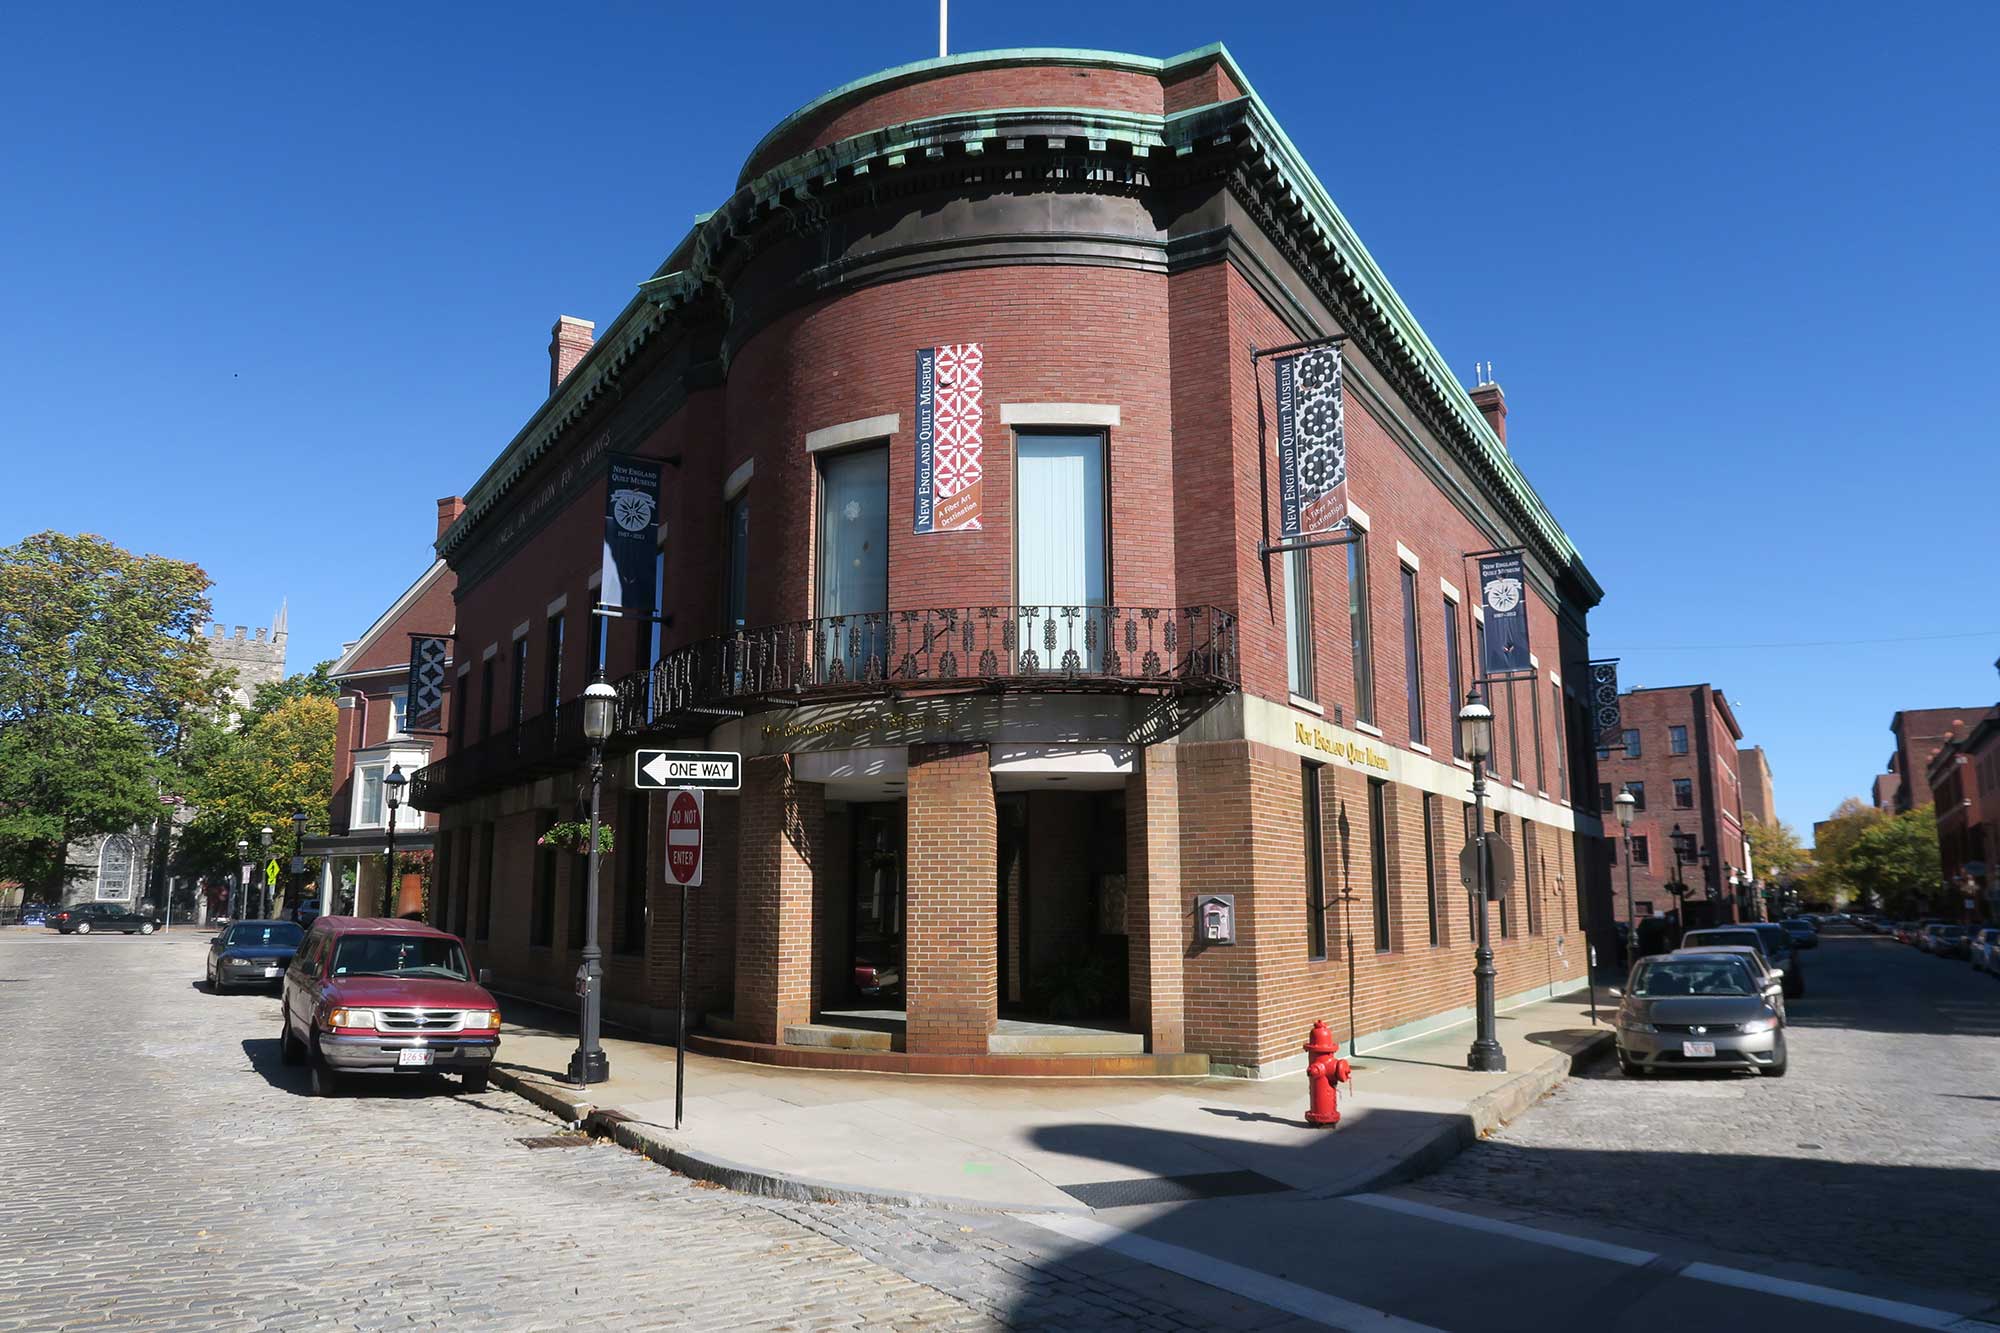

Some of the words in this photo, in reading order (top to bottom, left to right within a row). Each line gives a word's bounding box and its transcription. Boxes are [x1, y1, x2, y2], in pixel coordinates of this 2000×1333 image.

[920, 357, 932, 406] MUSEUM
[1281, 363, 1293, 413] MUSEUM
[919, 409, 931, 441] QUILT
[1282, 415, 1294, 447] QUILT
[612, 474, 629, 482] QUILT
[630, 476, 657, 487] MUSEUM
[613, 465, 627, 474] NEW
[629, 468, 657, 479] ENGLAND
[919, 442, 931, 495] ENGLAND
[1283, 449, 1296, 501] ENGLAND
[918, 495, 930, 525] NEW
[938, 510, 944, 518] A
[944, 501, 960, 514] Fiber
[960, 494, 971, 504] Art
[941, 502, 977, 526] Destination
[1286, 504, 1297, 532] NEW
[1309, 503, 1344, 530] Destination
[1295, 722, 1312, 746] NEW
[1314, 728, 1345, 757] ENGLAND
[1346, 742, 1365, 765] QUILT
[1366, 747, 1389, 771] MUSEUM
[669, 763, 698, 776] ONE
[702, 764, 729, 777] WAY
[672, 811, 680, 824] DO
[684, 810, 697, 824] NOT
[673, 851, 693, 865] ENTER
